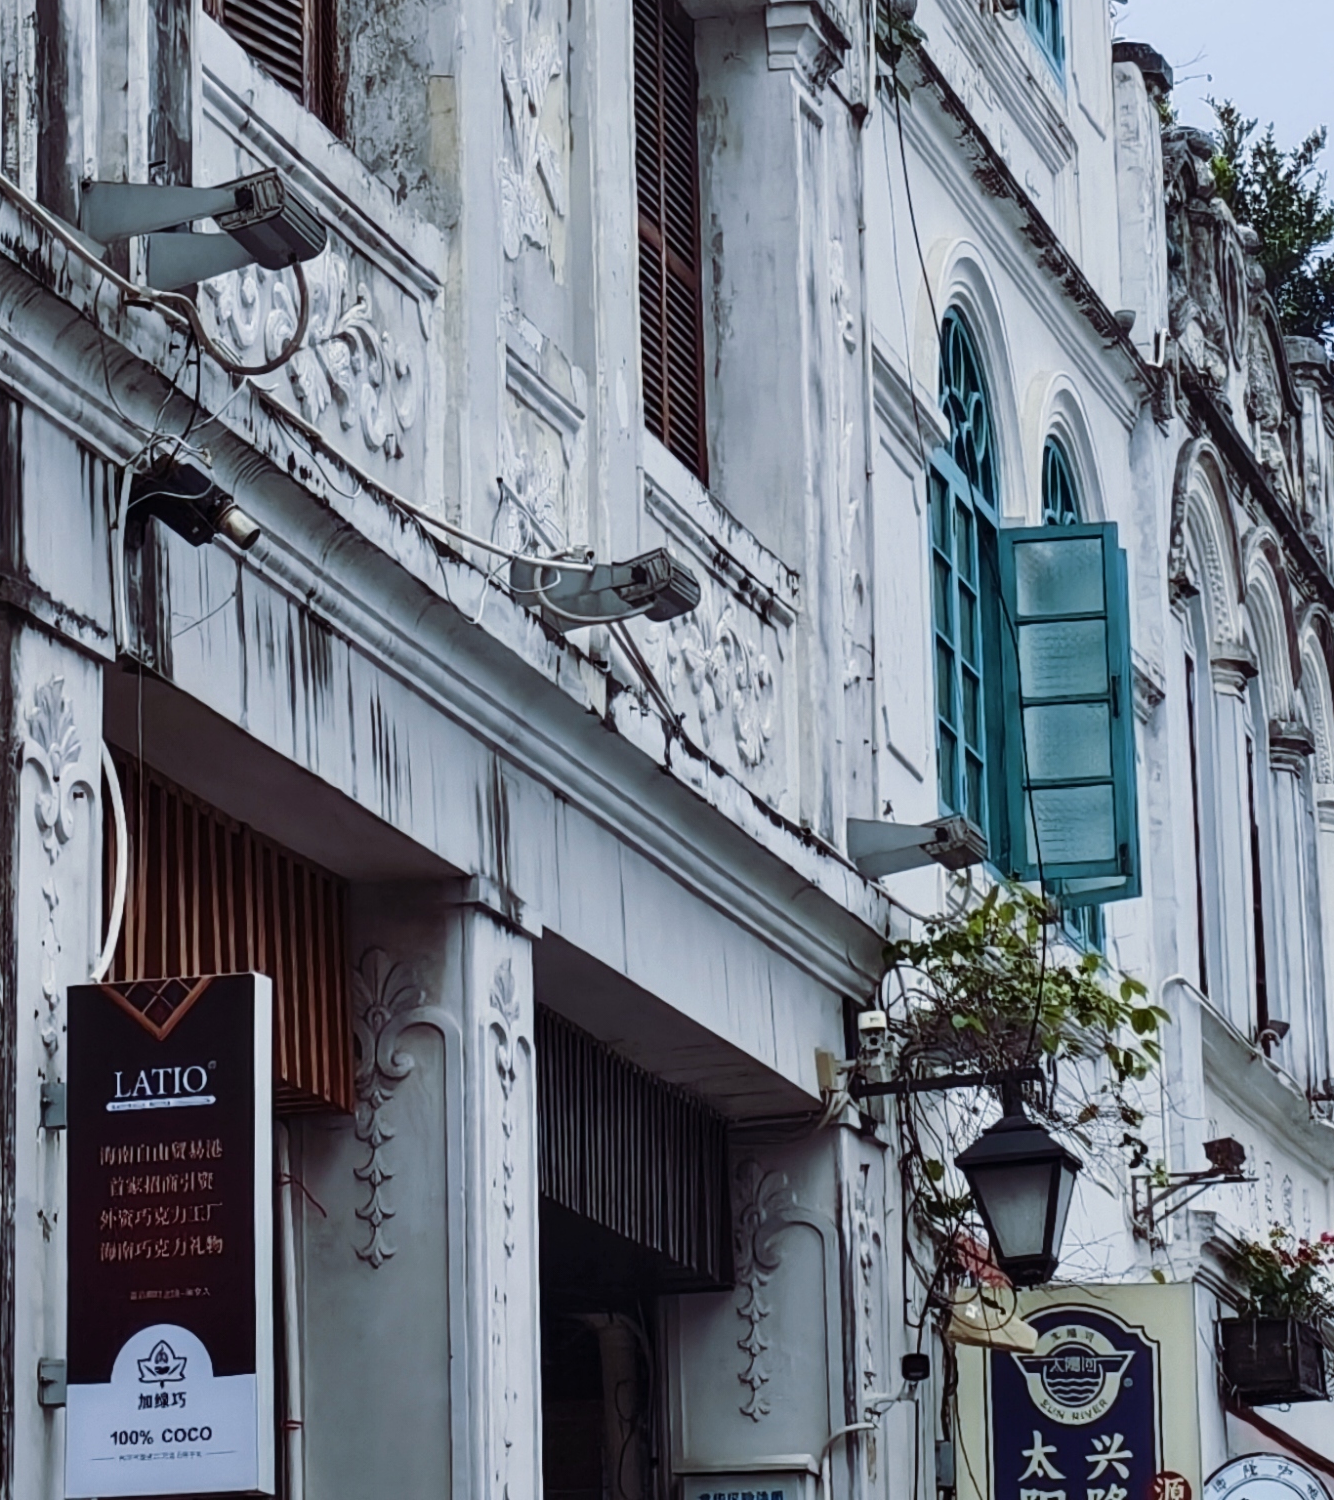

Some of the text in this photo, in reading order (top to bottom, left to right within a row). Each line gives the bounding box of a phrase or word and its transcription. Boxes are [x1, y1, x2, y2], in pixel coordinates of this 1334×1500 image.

[113, 1065, 208, 1098] LATIO
[100, 1138, 223, 1165] 海南自由贸易港
[100, 1202, 223, 1230] 外资巧克力工厂
[100, 1235, 224, 1262] 海南巧克力礼物
[137, 1391, 187, 1410] 加绿巧
[1071, 1398, 1109, 1421] RIVER
[110, 1426, 213, 1446] 100% COCO
[1017, 1429, 1067, 1500] 太
